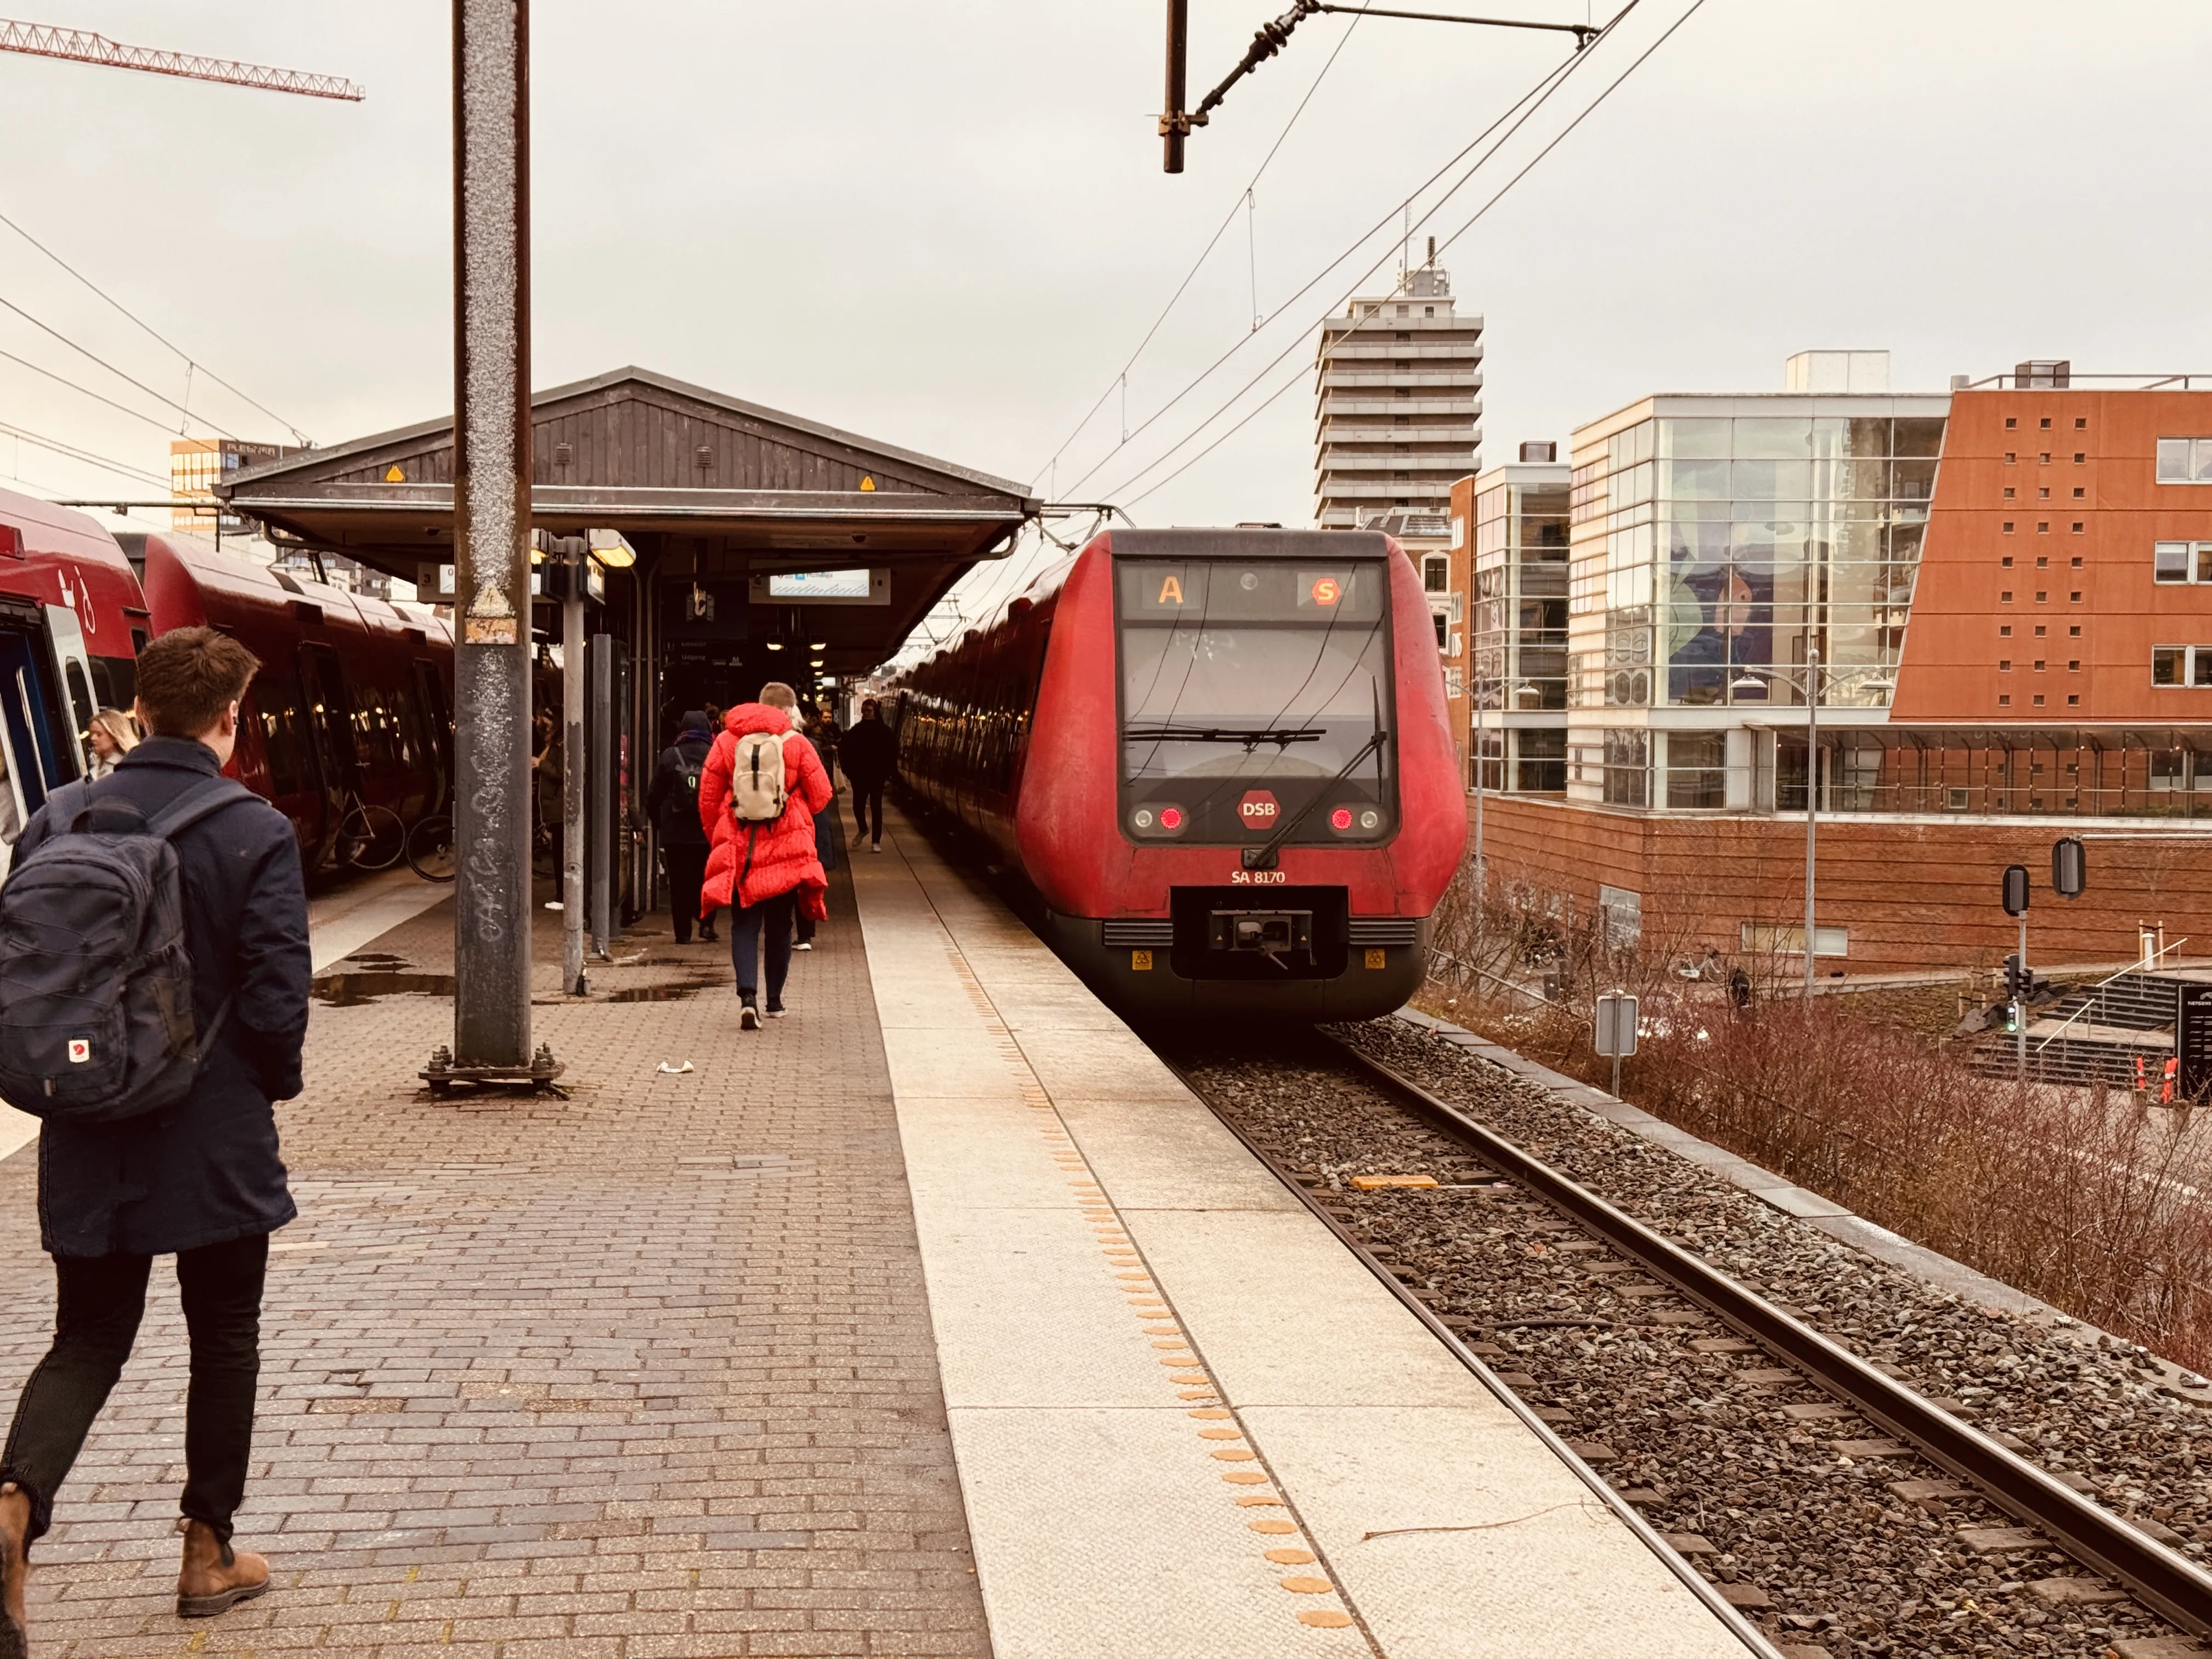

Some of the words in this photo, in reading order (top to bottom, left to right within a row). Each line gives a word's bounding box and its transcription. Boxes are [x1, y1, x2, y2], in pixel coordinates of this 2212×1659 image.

[424, 574, 431, 583] 3
[1158, 575, 1183, 603] A
[1317, 582, 1335, 600] S
[1243, 803, 1276, 816] DSB
[1231, 871, 1250, 883] SA
[1254, 871, 1285, 883] 8170
